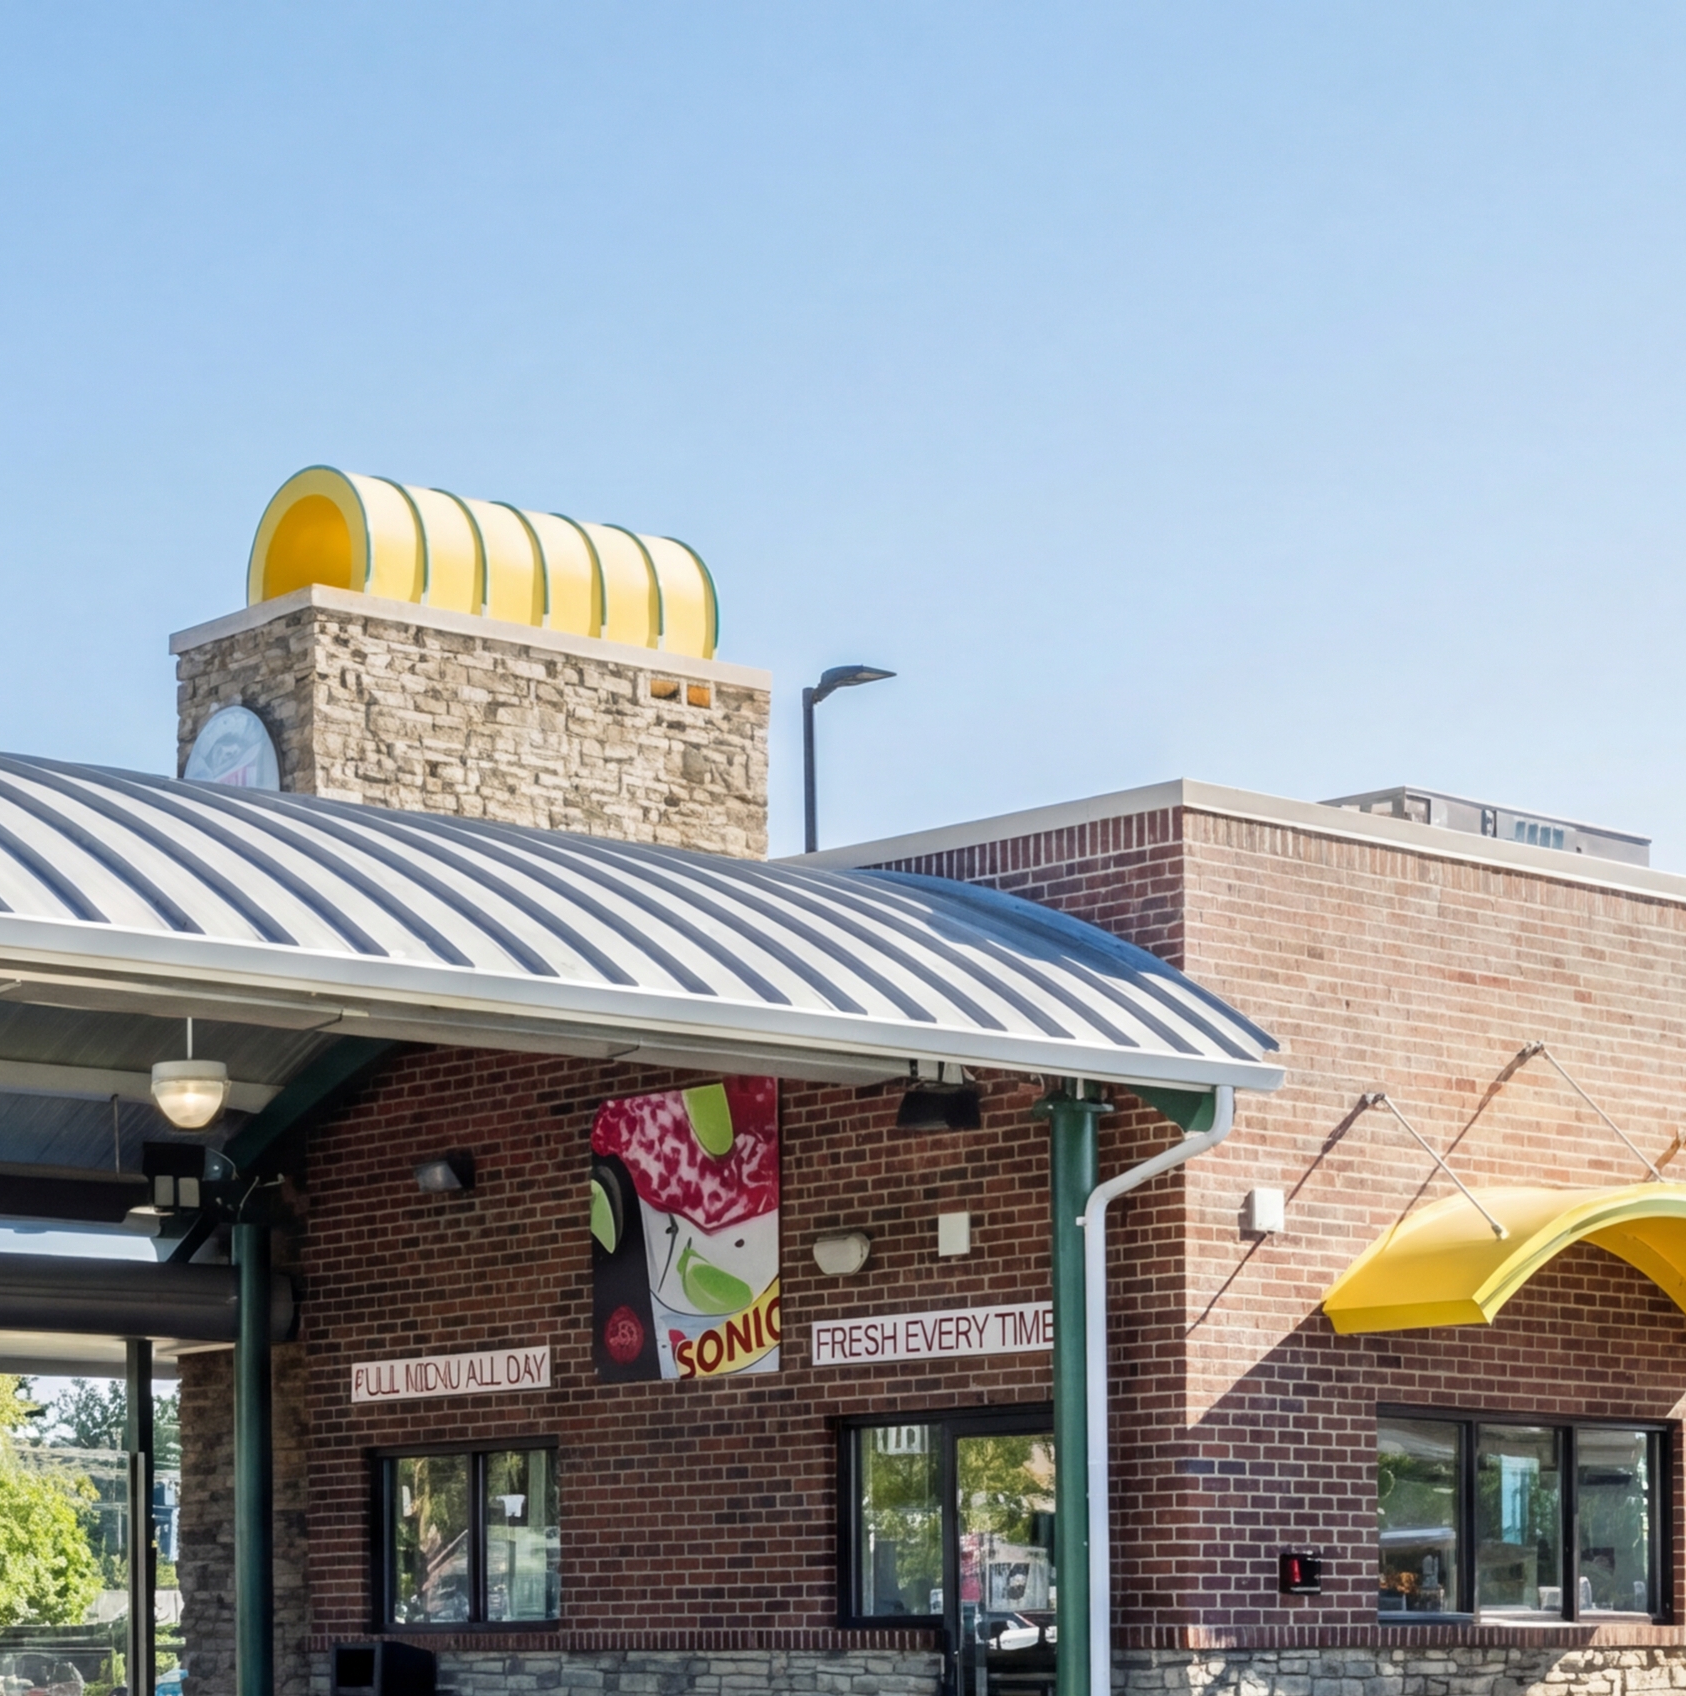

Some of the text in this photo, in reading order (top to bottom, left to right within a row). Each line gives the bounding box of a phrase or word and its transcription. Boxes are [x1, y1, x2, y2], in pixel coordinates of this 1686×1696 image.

[676, 1296, 780, 1380] SONIC
[816, 1308, 1054, 1361] FRESH EVERY TIME
[465, 1355, 502, 1389] ALL
[506, 1351, 547, 1385] DAY
